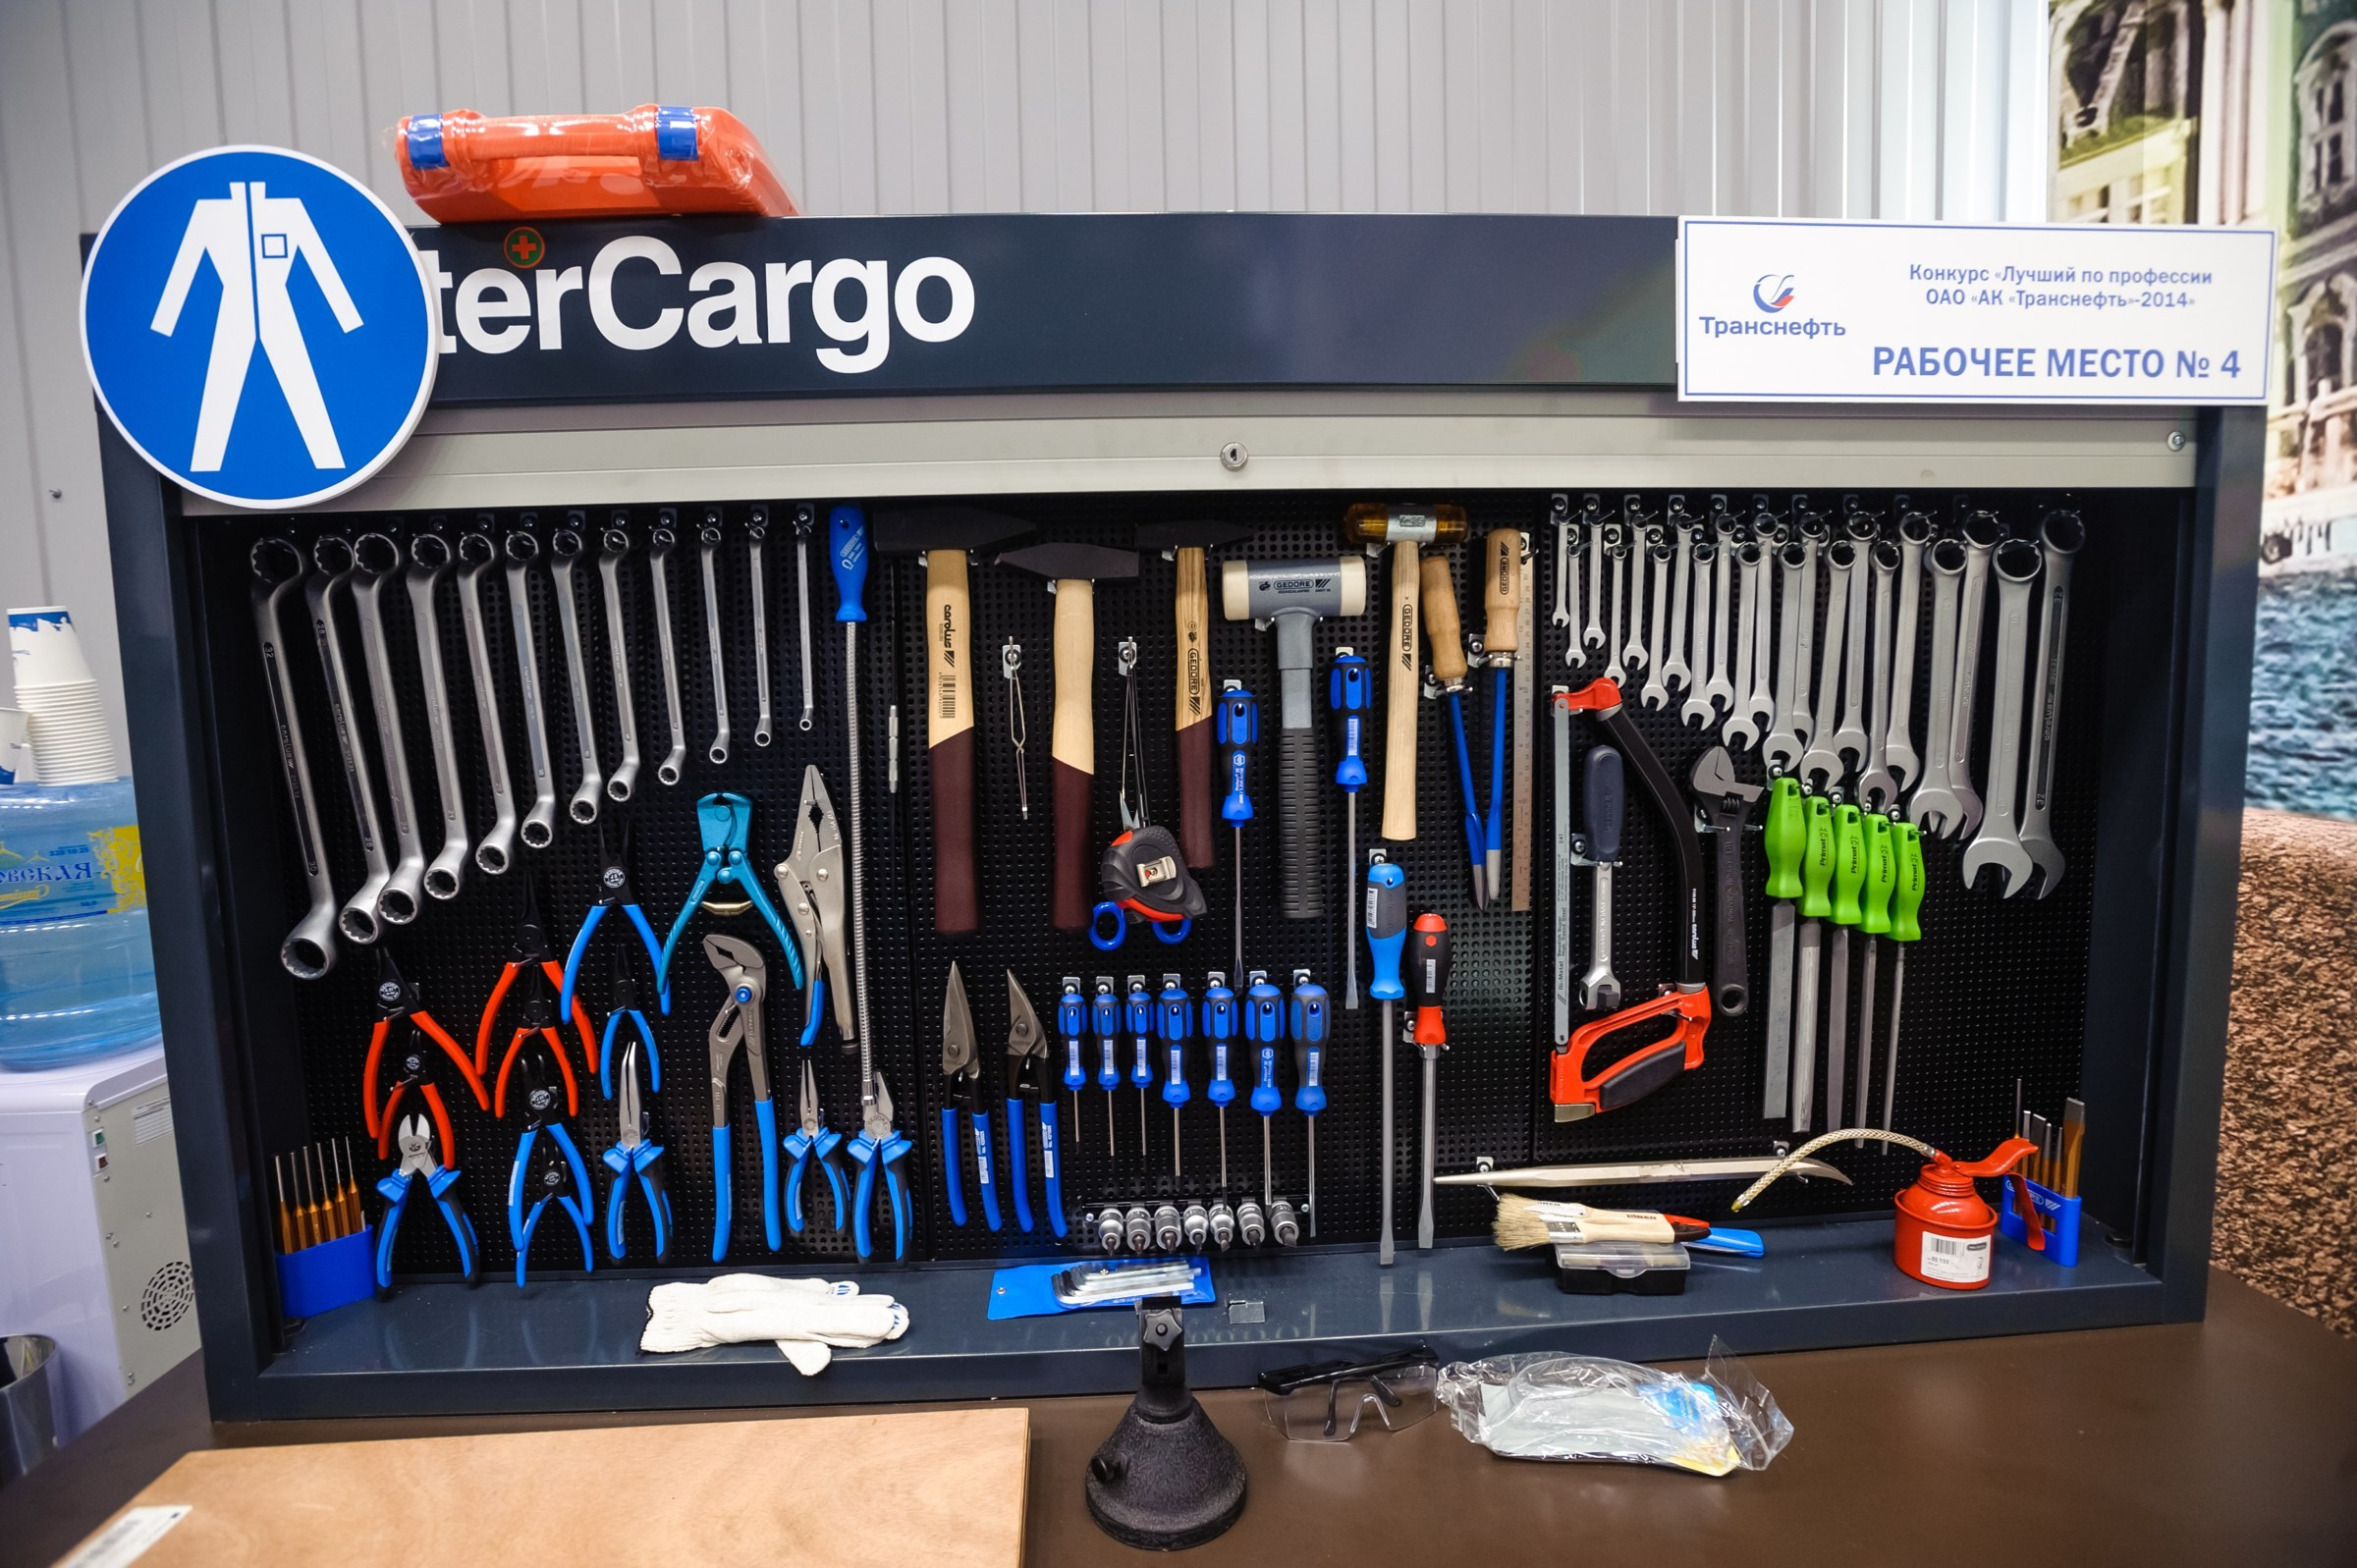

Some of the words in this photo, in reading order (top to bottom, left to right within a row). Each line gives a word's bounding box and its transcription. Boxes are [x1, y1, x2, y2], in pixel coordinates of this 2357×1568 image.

[1909, 263, 1990, 286] Конкурс
[1995, 264, 2076, 286] «Лучший
[2081, 270, 2104, 284] по
[2110, 267, 2213, 288] профессии
[1926, 288, 1965, 306] ОАО
[1971, 289, 2003, 306] «АК
[1698, 315, 1847, 338] Транснефть
[1873, 346, 2036, 378] РАБОЧЕЕ
[2047, 347, 2165, 379] МЕСТО
[2175, 350, 2210, 379] №
[2220, 350, 2242, 379] 4
[2054, 591, 2062, 604] 32
[943, 604, 957, 649] carolus
[1403, 607, 1412, 650] GEDORE
[265, 646, 274, 659] 32
[1189, 651, 1198, 692] GEDORE
[2044, 701, 2054, 741] carolus
[280, 725, 293, 761] carolus
[2036, 793, 2045, 805] 32
